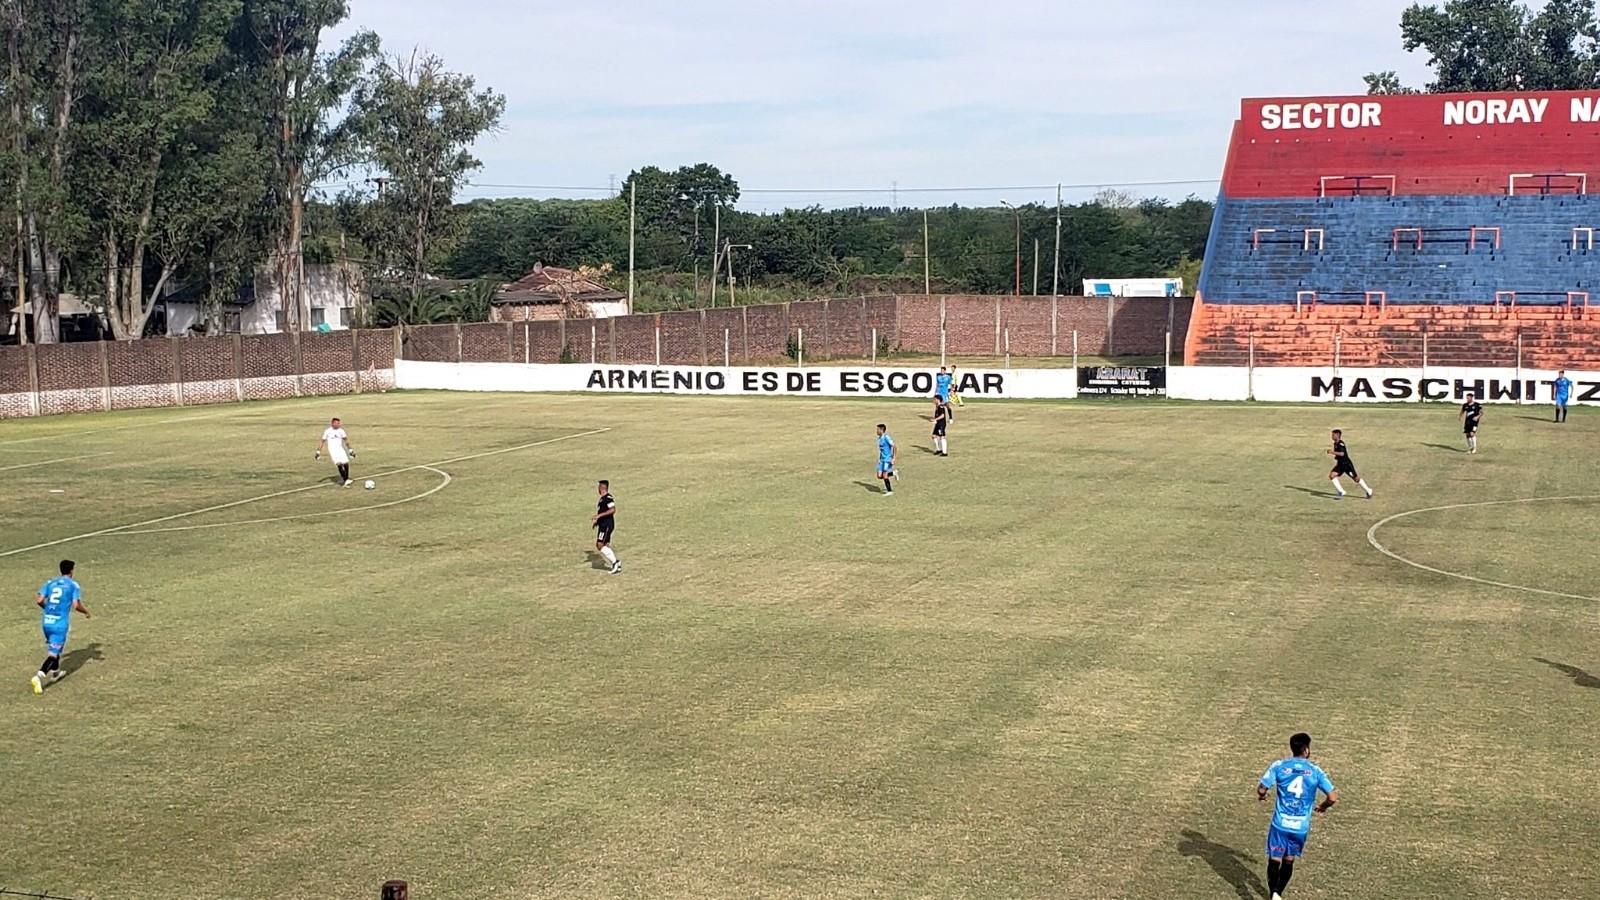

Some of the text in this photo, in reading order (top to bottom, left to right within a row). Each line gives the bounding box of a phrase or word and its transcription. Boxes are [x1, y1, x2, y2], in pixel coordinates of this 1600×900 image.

[1261, 102, 1382, 130] SECTOR
[1443, 98, 1549, 125] NORAY
[586, 369, 1004, 394] ARMENIO ES DE ESCOAR
[1096, 367, 1147, 380] ARARAT
[50, 587, 62, 604] 2
[1287, 776, 1304, 798] 4
